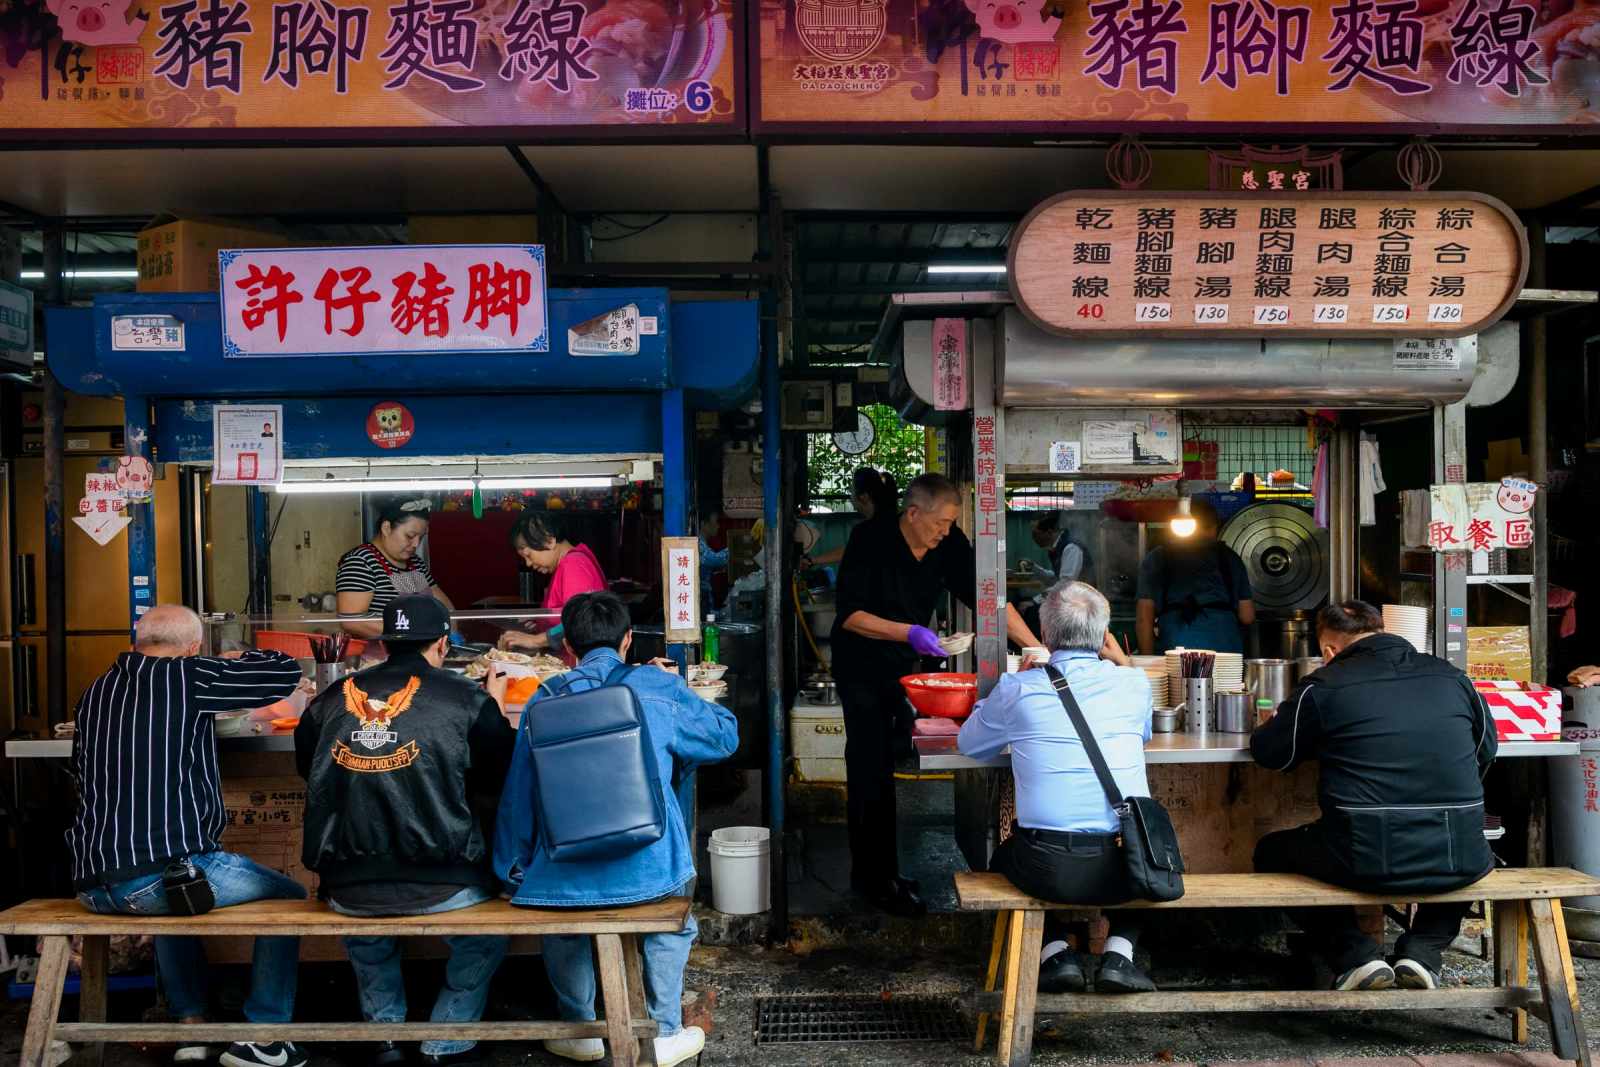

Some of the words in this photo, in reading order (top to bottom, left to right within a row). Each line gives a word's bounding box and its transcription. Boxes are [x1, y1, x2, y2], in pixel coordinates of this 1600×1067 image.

[154, 0, 598, 95] 豬腳麵線
[1084, 0, 1548, 97] 豬腳麵線
[794, 63, 889, 82] 大稻埕慈聖宮
[802, 82, 816, 90] DA
[819, 82, 842, 90] DAO
[844, 82, 881, 91] CHENG
[1241, 170, 1311, 190] 慈聖宮
[1072, 208, 1113, 298] 乾麵線
[1134, 208, 1176, 298] 豬腳麵線
[1194, 208, 1237, 298] 豬腳湯
[1254, 207, 1297, 298] 腿肉麵線
[1313, 207, 1357, 298] 腿肉湯
[1372, 208, 1416, 298] 綜合麵線
[1429, 207, 1474, 298] 綜合湯
[1077, 304, 1103, 318] 40
[1140, 305, 1169, 319] 150
[1198, 306, 1226, 319] 130
[1258, 307, 1288, 321] 150
[1319, 306, 1344, 319] 130
[1376, 306, 1405, 320] 150
[1433, 305, 1460, 319] 130
[976, 416, 998, 537] 營業時間早上
[1429, 518, 1533, 550] 取餐區
[677, 555, 690, 622] 請先付款
[395, 609, 410, 630] LA
